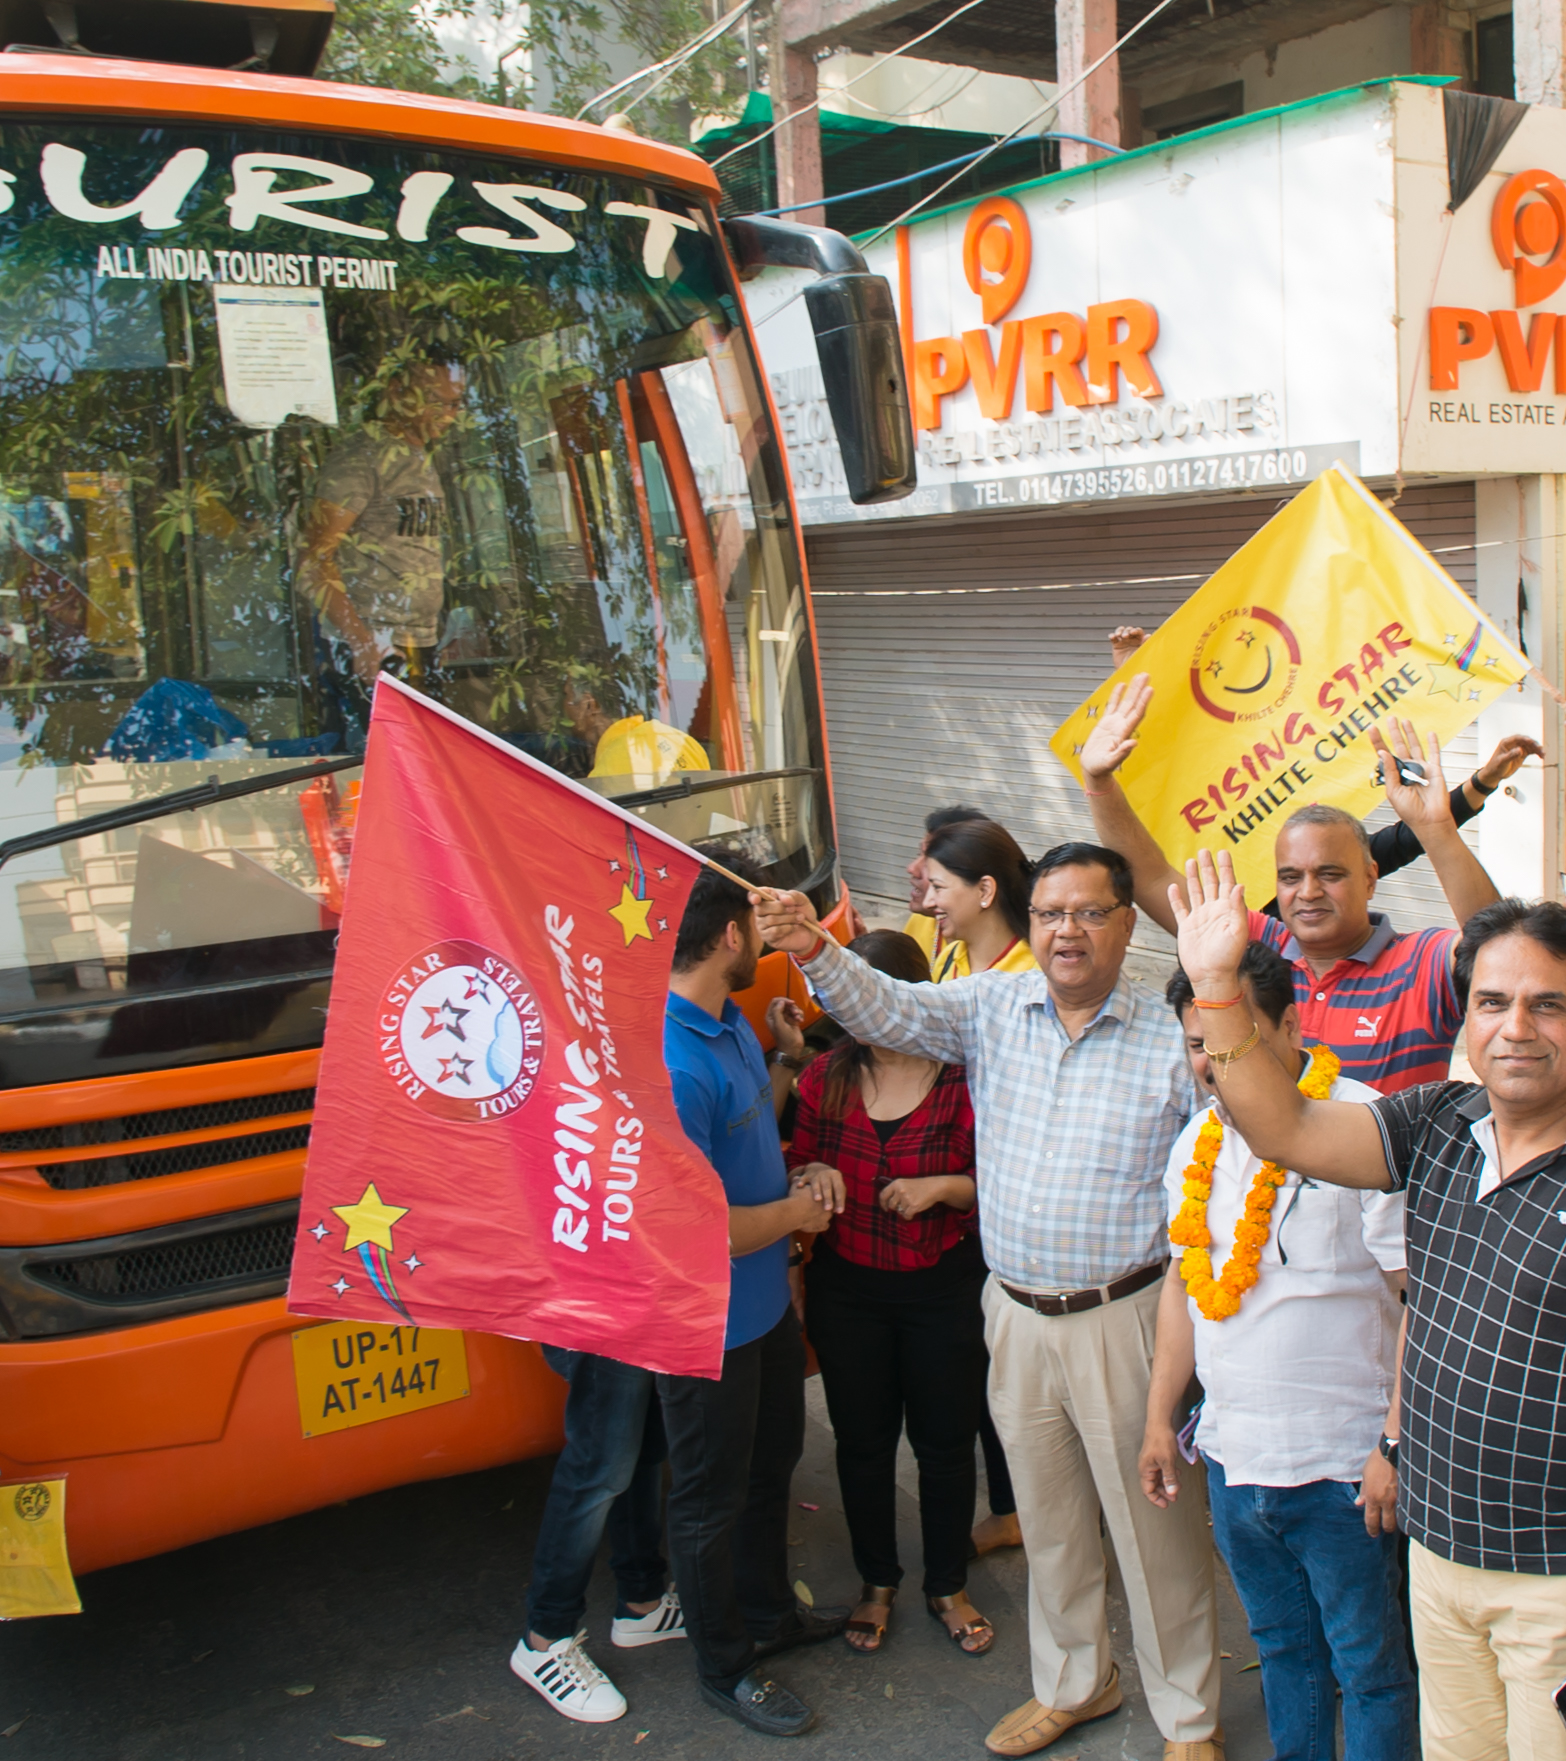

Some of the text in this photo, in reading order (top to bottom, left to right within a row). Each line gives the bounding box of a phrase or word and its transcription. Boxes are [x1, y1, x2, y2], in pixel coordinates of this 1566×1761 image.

[97, 246, 399, 291] ALL INDIA TOURIST PERMIT
[912, 298, 1163, 430] PVRR
[1429, 401, 1481, 424] REAL
[1489, 403, 1556, 425] ESTATE
[973, 481, 1015, 506] TEL.
[1191, 607, 1249, 666] RISING STAR
[1180, 621, 1414, 834] RISING STAR
[1222, 662, 1423, 845] KHILTE CHEHRE
[1236, 705, 1275, 723] KHILTE
[380, 952, 446, 1101] RISING STAR
[475, 956, 543, 1119] TOURS & TRAVELS
[544, 903, 603, 1253] RISING STAR
[602, 1115, 645, 1243] TOURS
[322, 1358, 440, 1418] AT-1447
[332, 1325, 420, 1369] UP-17
